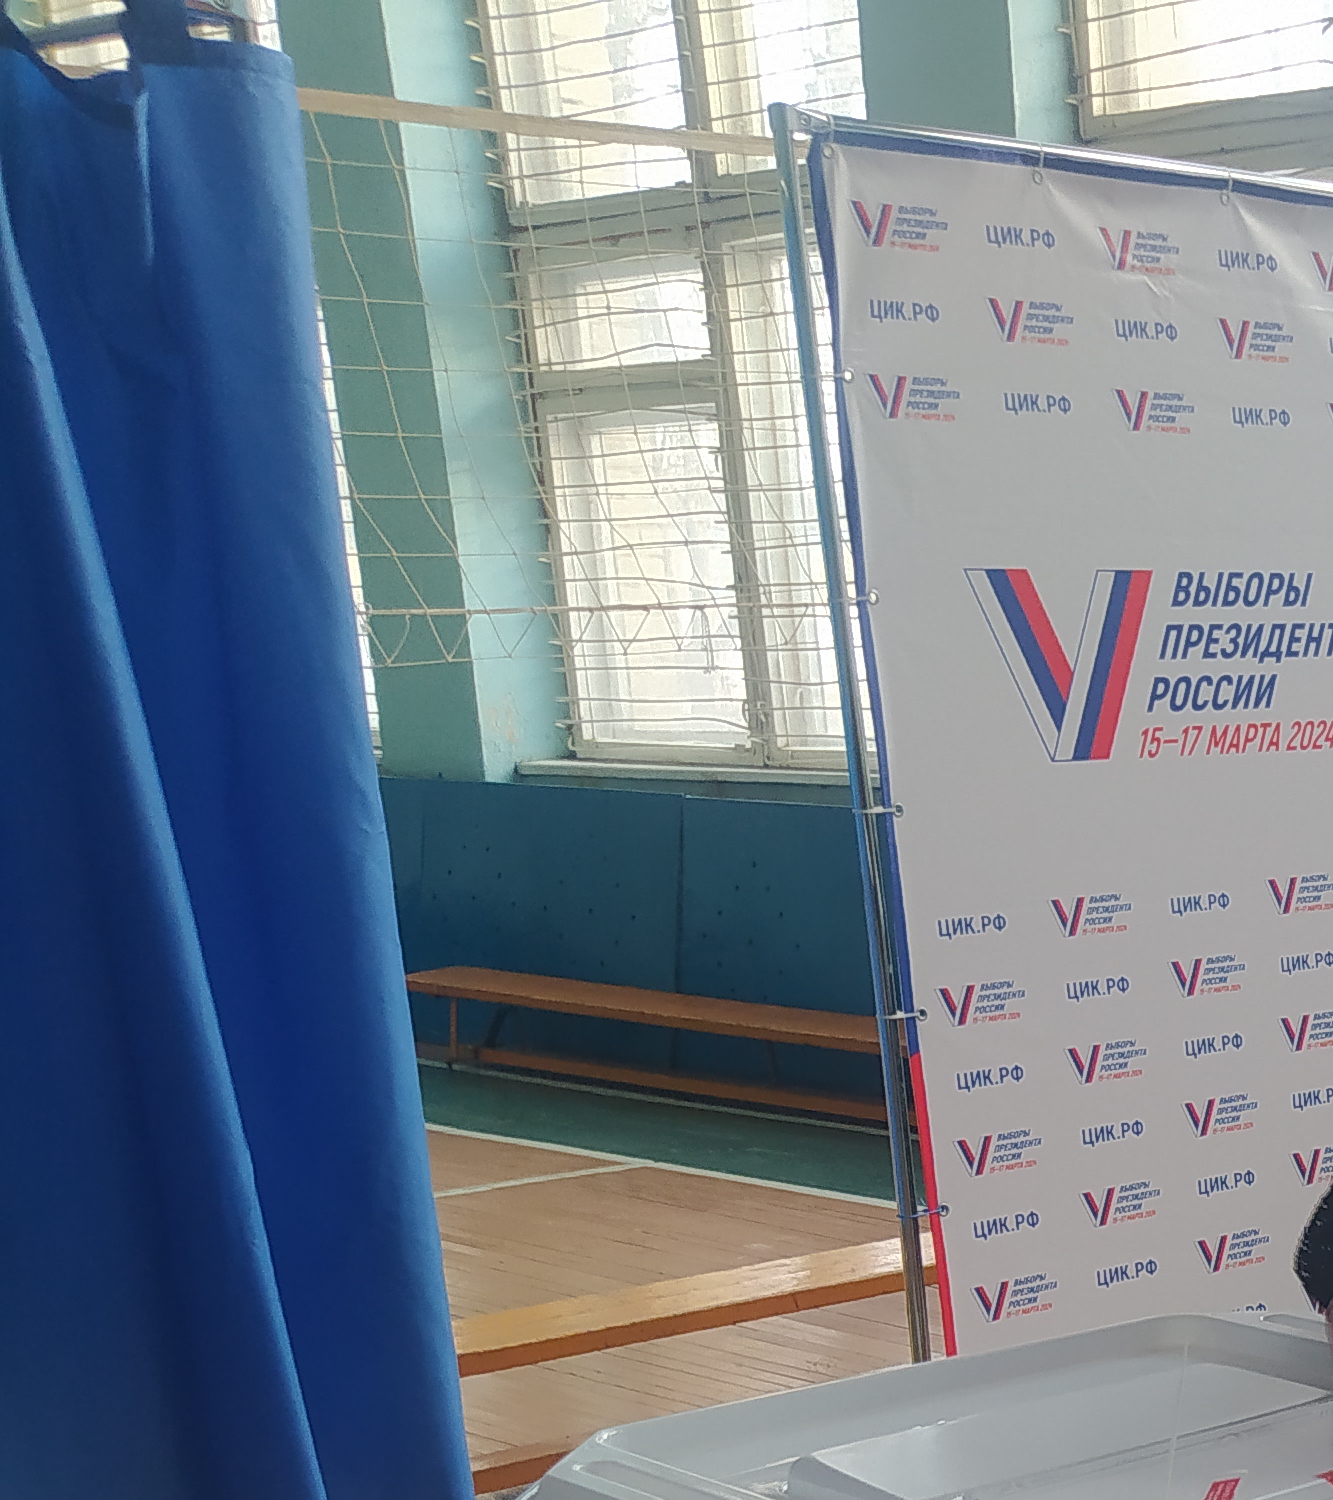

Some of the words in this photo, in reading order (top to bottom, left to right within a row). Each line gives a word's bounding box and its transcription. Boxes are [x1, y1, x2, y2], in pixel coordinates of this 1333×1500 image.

[985, 226, 1056, 248] ЦИК.РФ
[1217, 251, 1278, 272] ЦИК.РФ
[869, 299, 940, 322] ЦИК.РФ
[1114, 320, 1178, 341] ЦИК.РФ
[1003, 393, 1072, 415] ЦИК.РФ
[1231, 408, 1291, 428] ЦИК.РФ
[1171, 572, 1312, 607] ВЫБОРЫ
[1148, 674, 1278, 712] РОССИИ
[1206, 722, 1281, 755] МАРТА
[1300, 873, 1330, 883] ВЫБОРЫ
[1089, 893, 1122, 904] ВЫБОРЫ
[1170, 893, 1230, 916] ЦИК.РФ
[1086, 904, 1132, 914] ПРЕЗИДЕНТА
[937, 914, 1007, 940] ЦИК.РФ
[1083, 916, 1114, 925] РОССИИ
[1205, 954, 1237, 964] ВЫБОРЫ
[1204, 964, 1246, 974] ПРЕЗИДЕНТА
[979, 980, 1015, 991] ВЫБОРЫ
[1201, 976, 1229, 984] РОССИИ
[1066, 976, 1130, 1002] ЦИК.РФ
[977, 990, 1026, 1002] ПРЕЗИДЕНТА
[973, 1004, 1006, 1014] РОССИИ
[1105, 1039, 1138, 1050] ВЫБОРЫ
[1184, 1033, 1244, 1058] ЦИК.РФ
[1102, 1049, 1147, 1061] ПРЕЗИДЕНТА
[1099, 1062, 1129, 1072] РОССИИ
[956, 1065, 1024, 1092] ЦИК.РФ
[1219, 1094, 1249, 1104] ВЫБОРЫ
[1217, 1102, 1258, 1115] ПРЕЗИДЕНТА
[1213, 1115, 1241, 1124] РОССИИ
[996, 1129, 1032, 1141] ВЫБОРЫ
[1081, 1120, 1144, 1147] ЦИК.РФ
[993, 1138, 1042, 1152] ПРЕЗИДЕНТА
[991, 1152, 1023, 1162] РОССИИ
[1119, 1181, 1152, 1193] ВЫБОРЫ
[1197, 1170, 1256, 1197] ЦИК.РФ
[1116, 1190, 1161, 1204] ПРЕЗИДЕНТА
[1114, 1203, 1143, 1213] РОССИИ
[973, 1212, 1040, 1240] ЦИК.РФ
[1231, 1229, 1261, 1240] ВЫБОРЫ
[1229, 1236, 1270, 1250] ПРЕЗИДЕНТА
[1227, 1250, 1253, 1260] РОССИИ
[1013, 1273, 1048, 1287] ВЫБОРЫ
[1096, 1260, 1158, 1288] ЦИК.РФ
[1010, 1282, 1058, 1297] ПРЕЗИДЕНТА
[1008, 1296, 1039, 1307] РОССИИ
